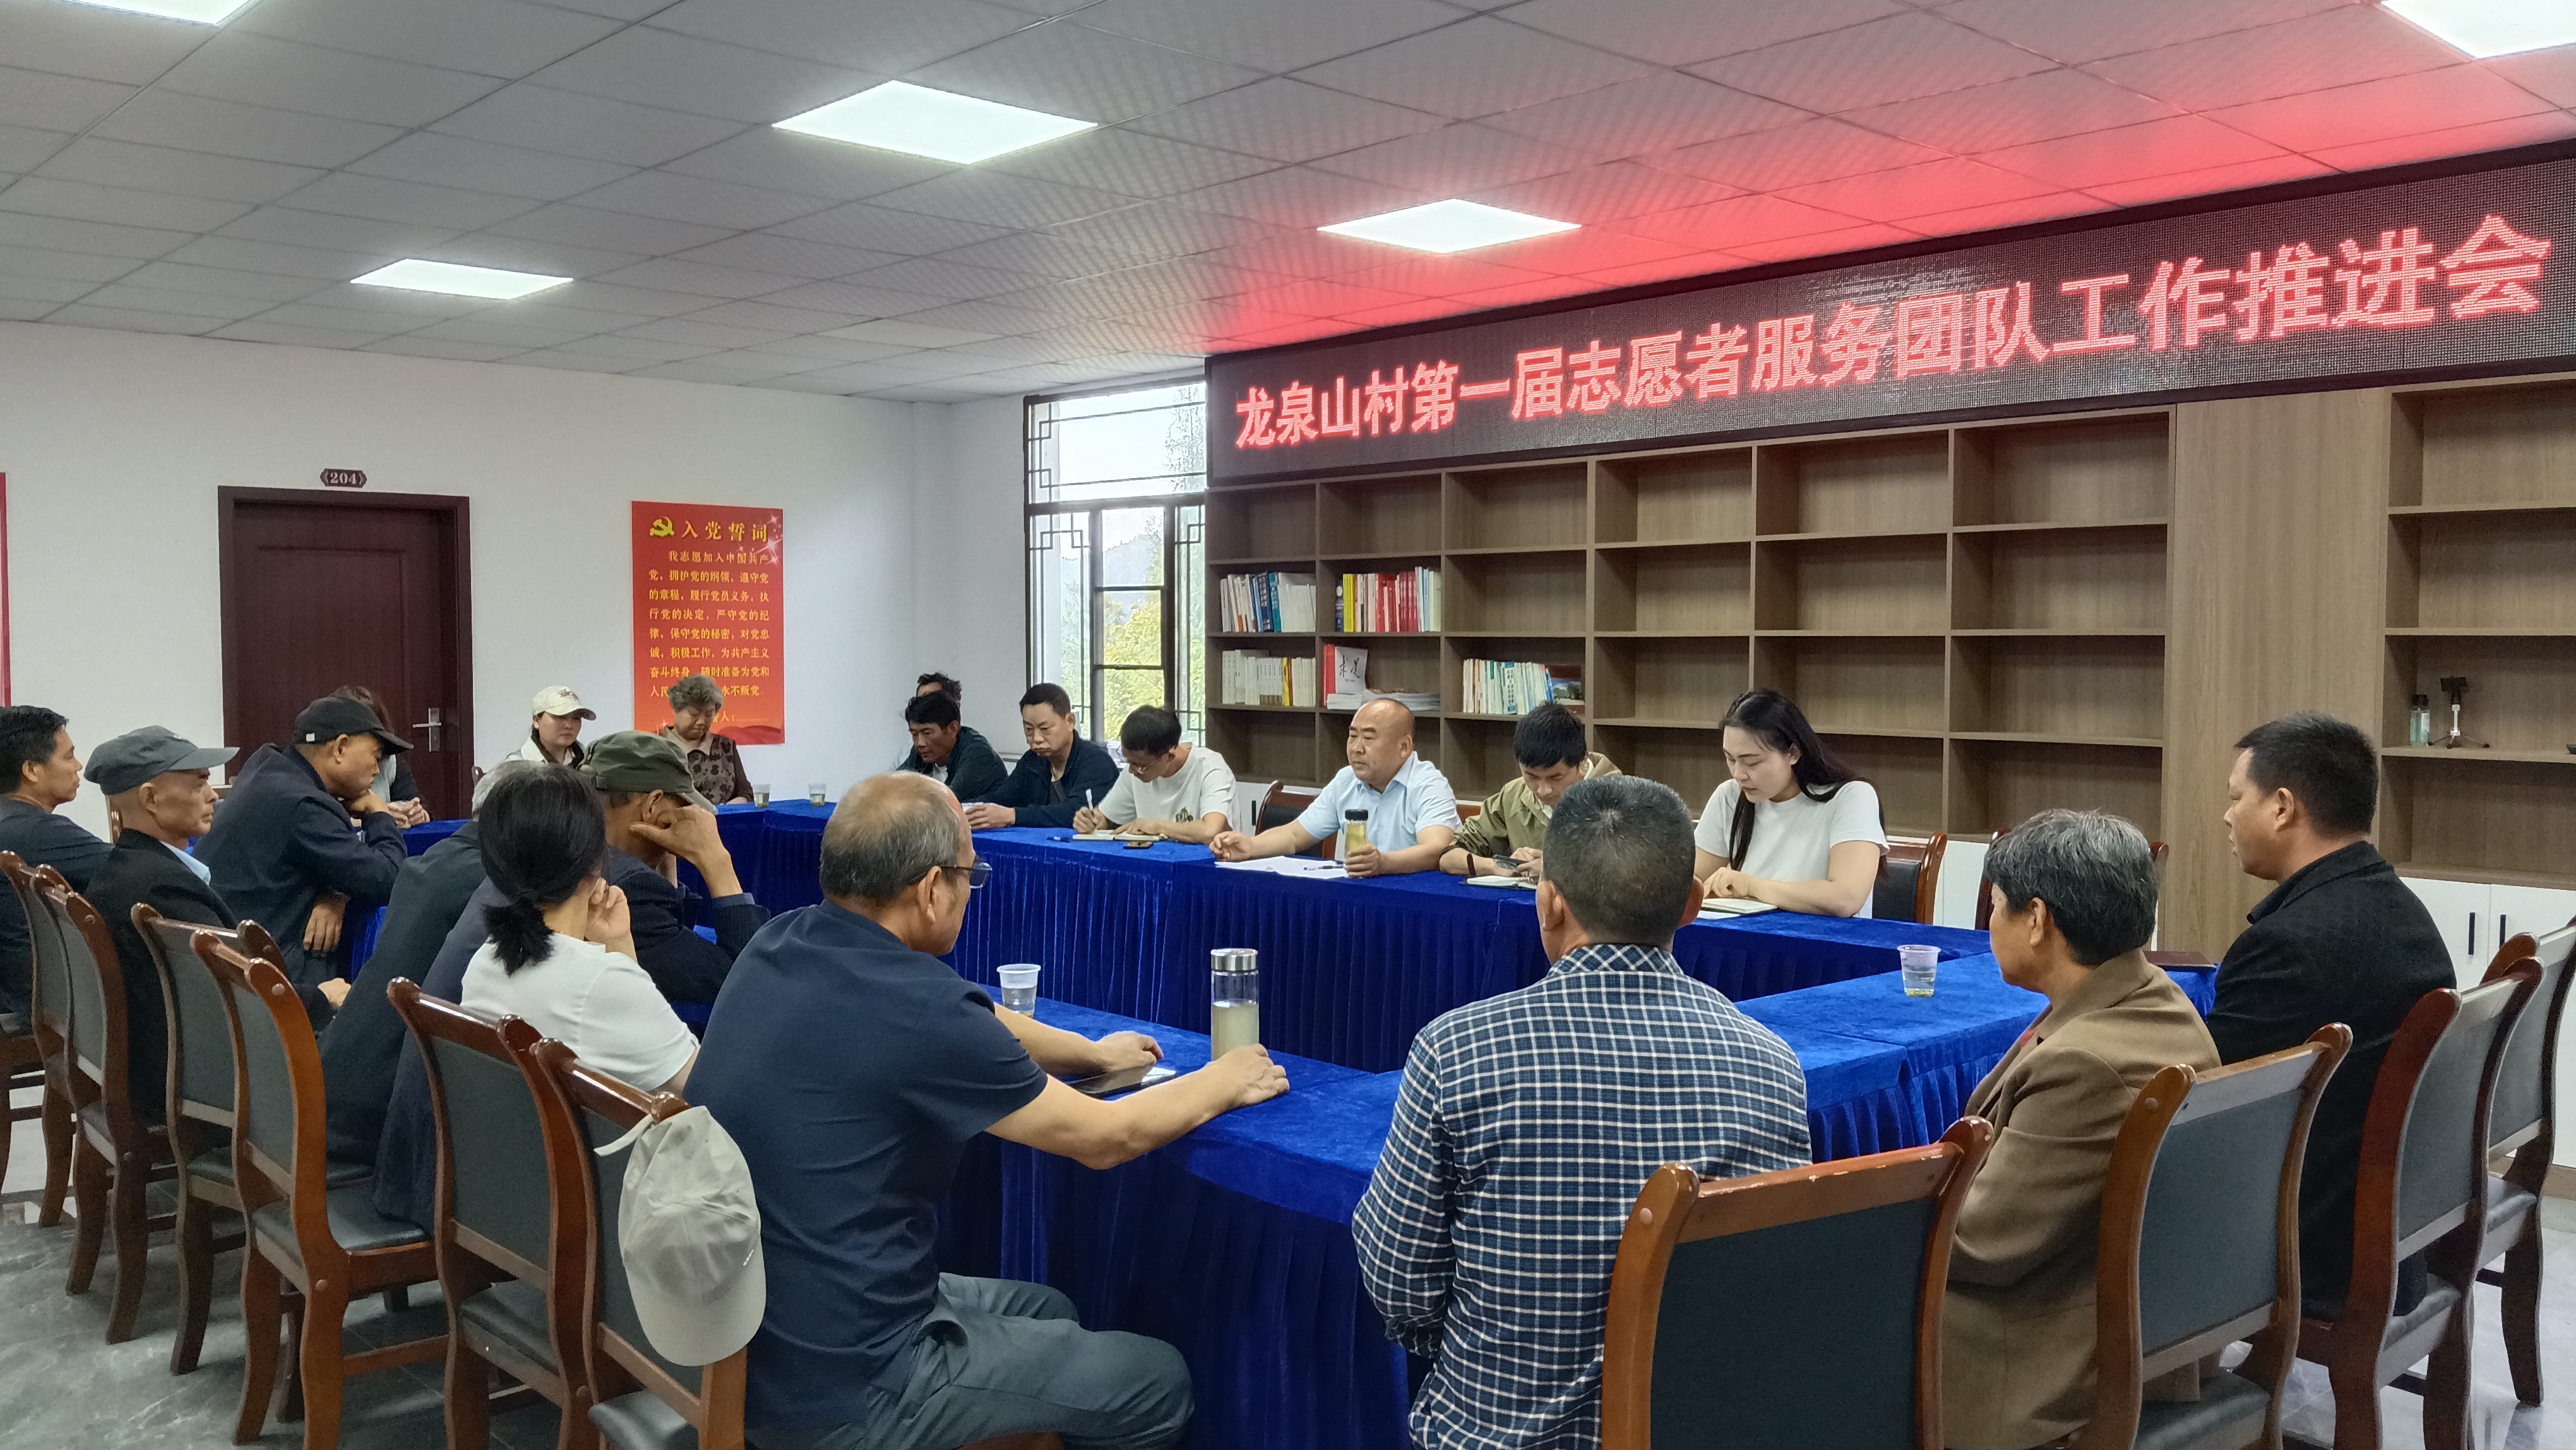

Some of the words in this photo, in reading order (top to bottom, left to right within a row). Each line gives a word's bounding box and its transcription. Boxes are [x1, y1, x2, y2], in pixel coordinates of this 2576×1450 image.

[1235, 214, 2552, 448] 龙泉山村第一届志愿者服务团队工作推进会
[681, 520, 767, 542] 入党誓词
[668, 550, 768, 565] 我志愿加入中国共产
